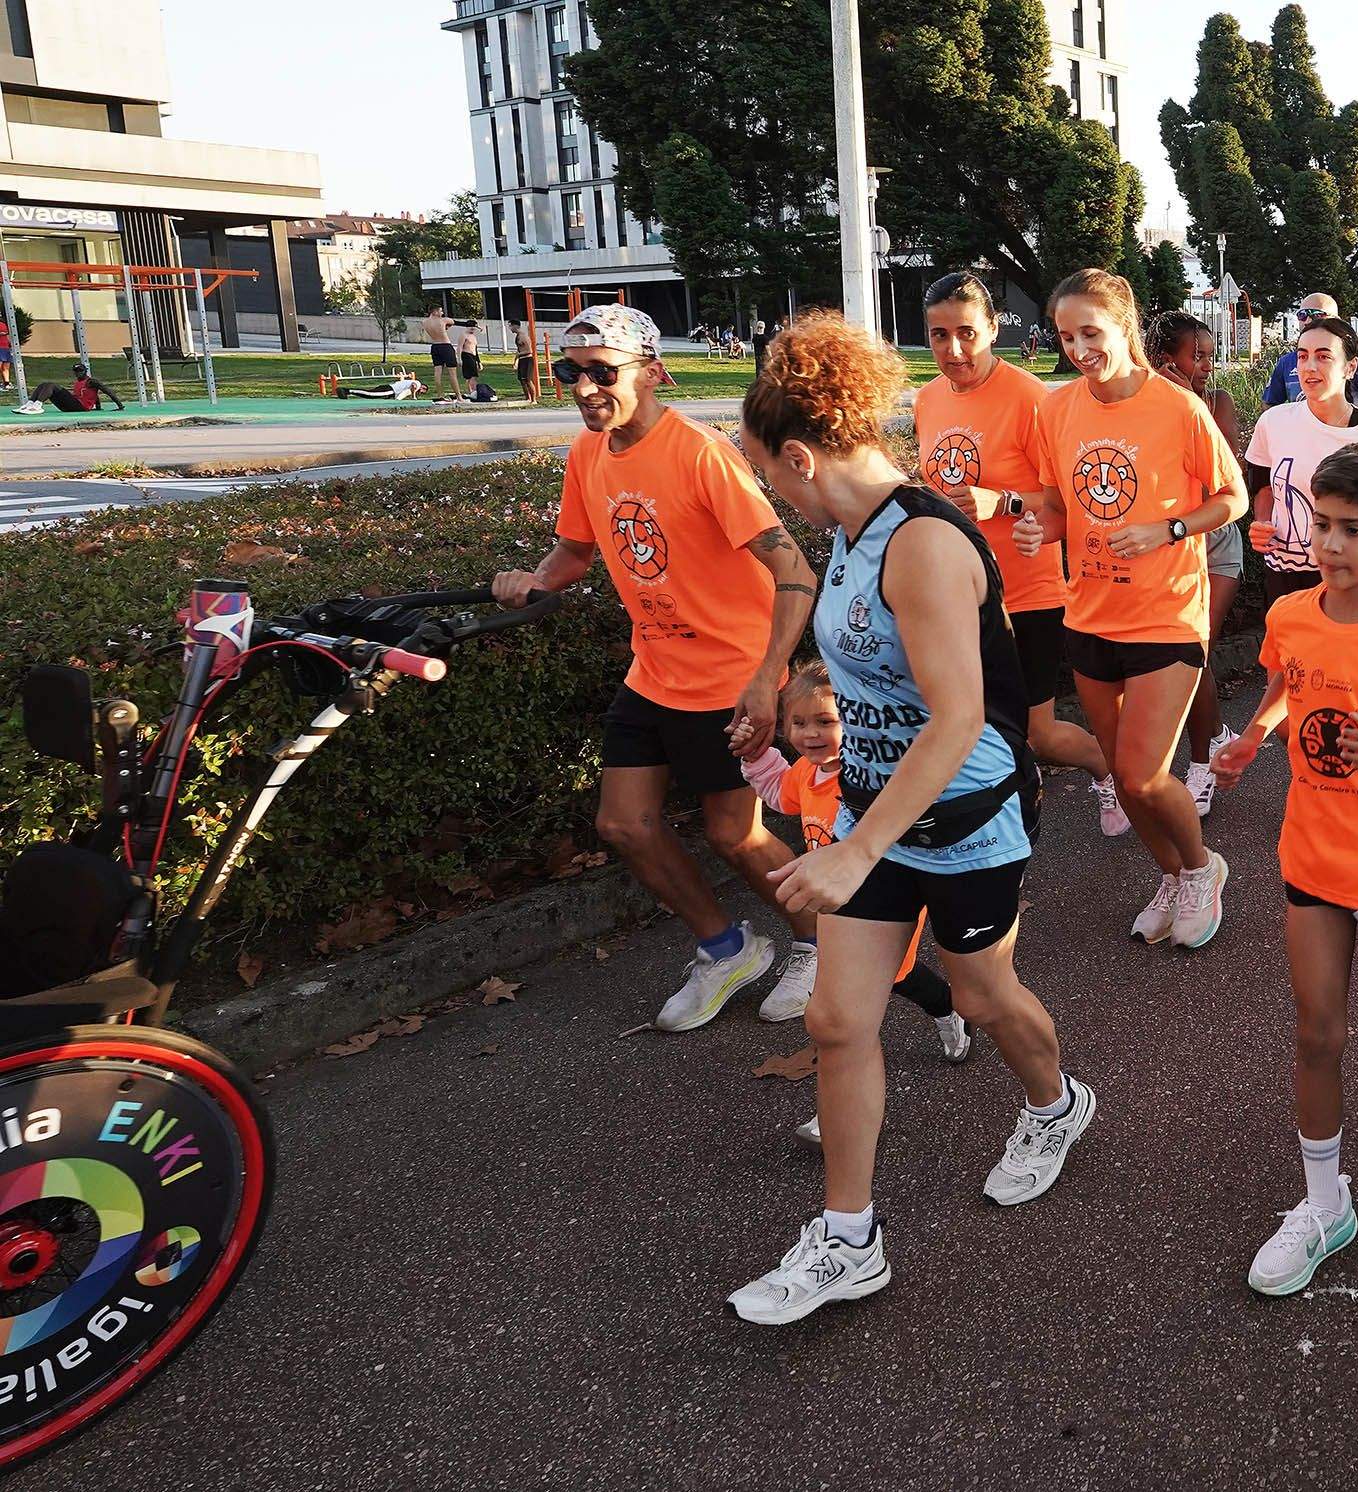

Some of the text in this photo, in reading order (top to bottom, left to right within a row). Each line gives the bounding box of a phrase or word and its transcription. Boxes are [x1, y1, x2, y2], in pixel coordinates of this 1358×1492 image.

[0, 206, 114, 226] ovacesa
[0, 1100, 203, 1187] ia ENKI
